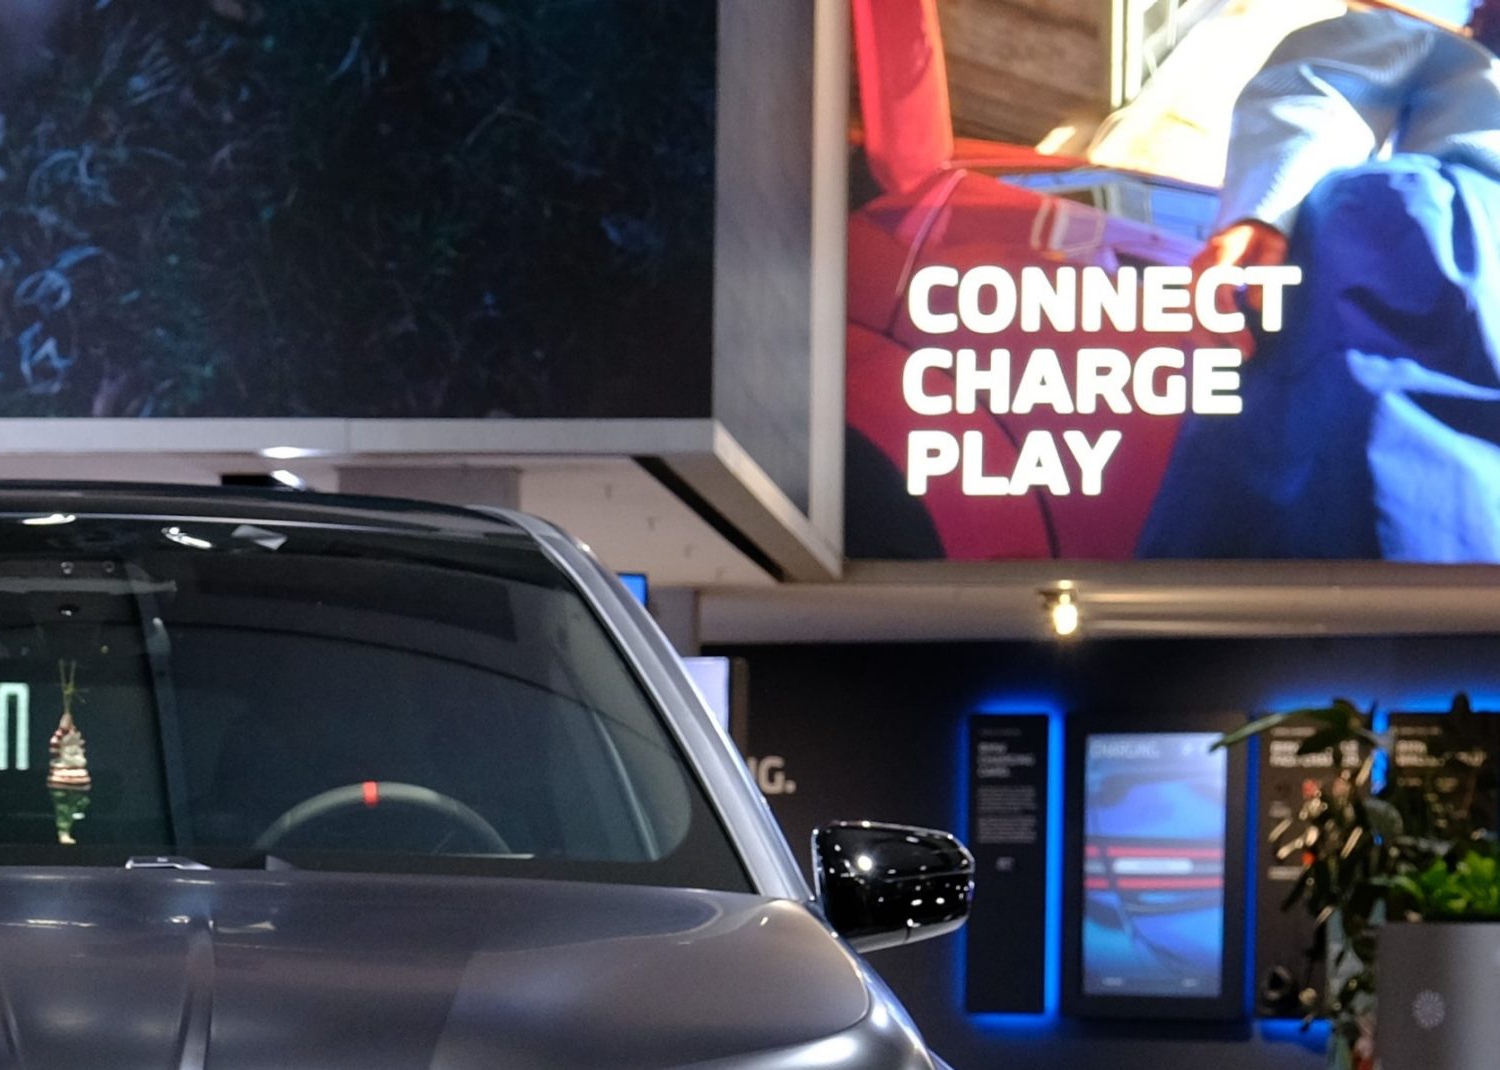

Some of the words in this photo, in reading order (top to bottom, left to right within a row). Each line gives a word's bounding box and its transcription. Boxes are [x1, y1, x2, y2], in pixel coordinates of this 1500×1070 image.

[907, 265, 1302, 333] CONNECT
[902, 347, 1243, 416] CHARGE
[907, 430, 1122, 496] PLAY
